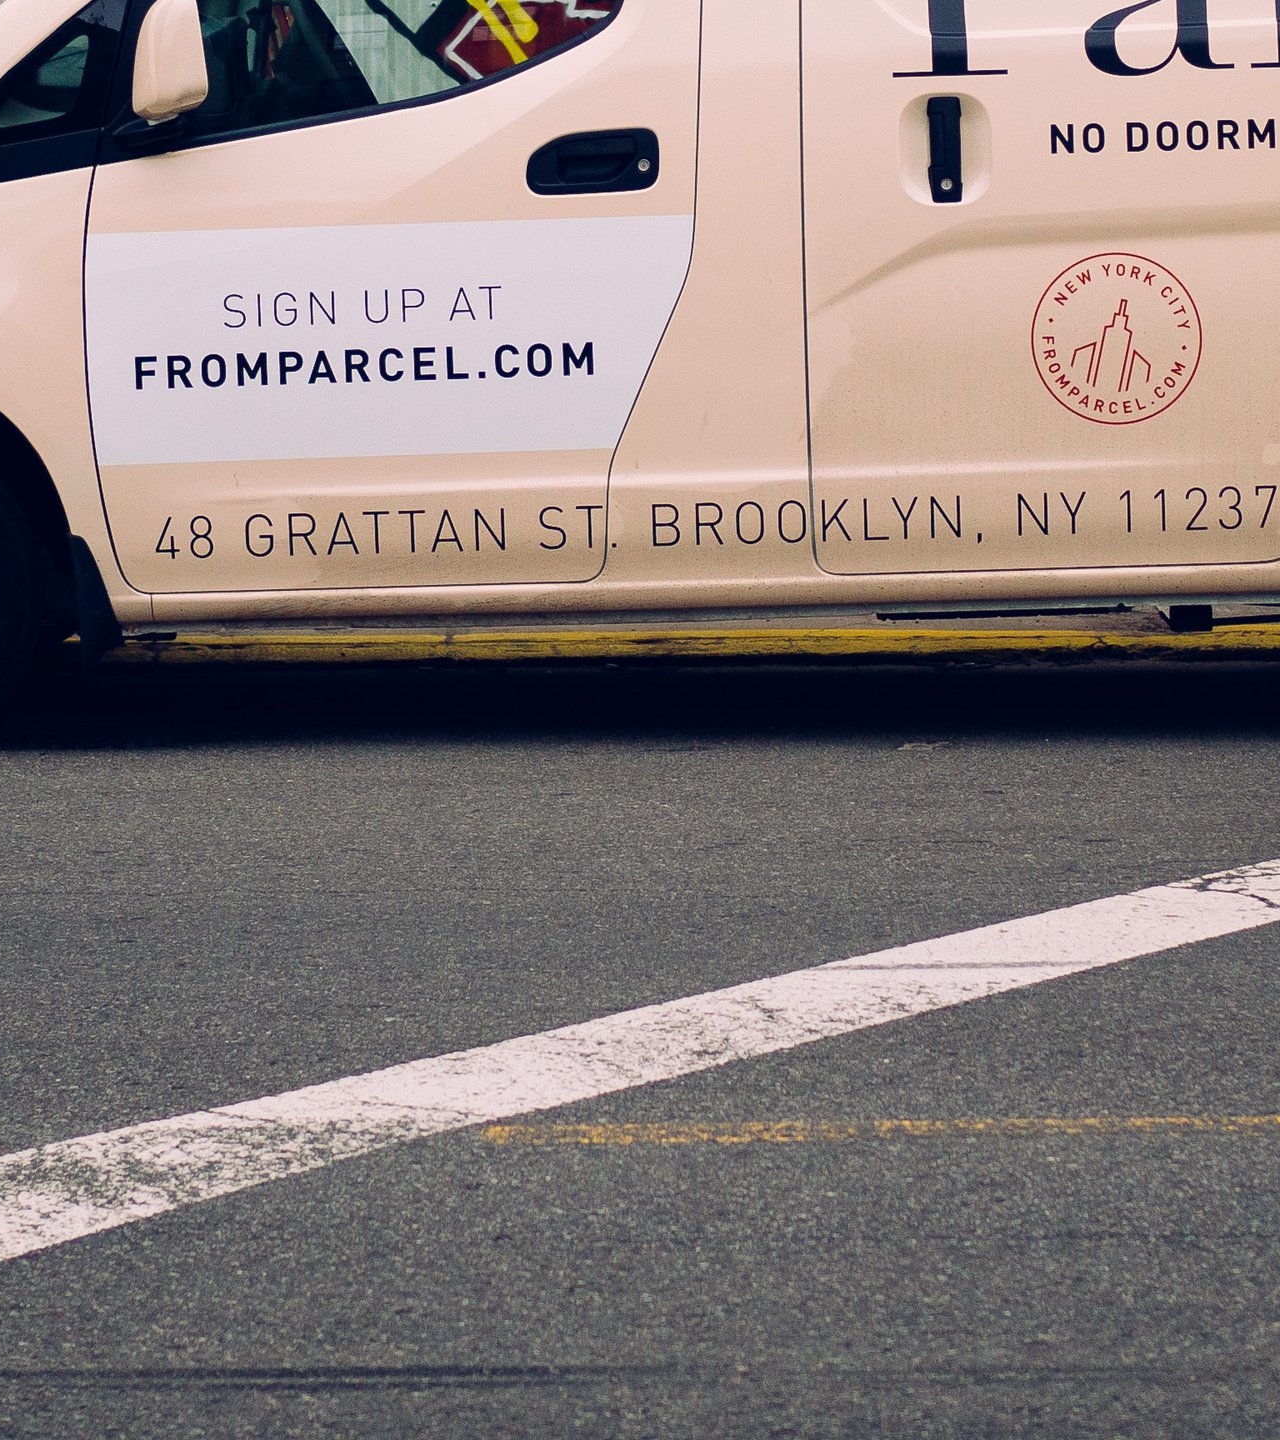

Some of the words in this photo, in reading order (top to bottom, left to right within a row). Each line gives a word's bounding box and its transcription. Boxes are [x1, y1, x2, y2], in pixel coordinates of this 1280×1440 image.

[1049, 123, 1107, 155] NO
[222, 289, 338, 329] SIGN
[363, 288, 426, 324] UP
[448, 285, 502, 322] AT
[1053, 269, 1092, 307] NEW
[1101, 263, 1156, 286] YORK
[1160, 286, 1191, 330] CITY
[133, 341, 596, 391] FROMPARCEL.COM
[1042, 336, 1186, 414] FROMPARCEL.COM
[154, 515, 215, 560] 48
[243, 507, 508, 557] GRATTAN
[538, 504, 618, 550] ST.
[651, 493, 983, 549] BROOKLYN,
[1017, 491, 1087, 537] NY
[1119, 485, 1279, 534] 11237
